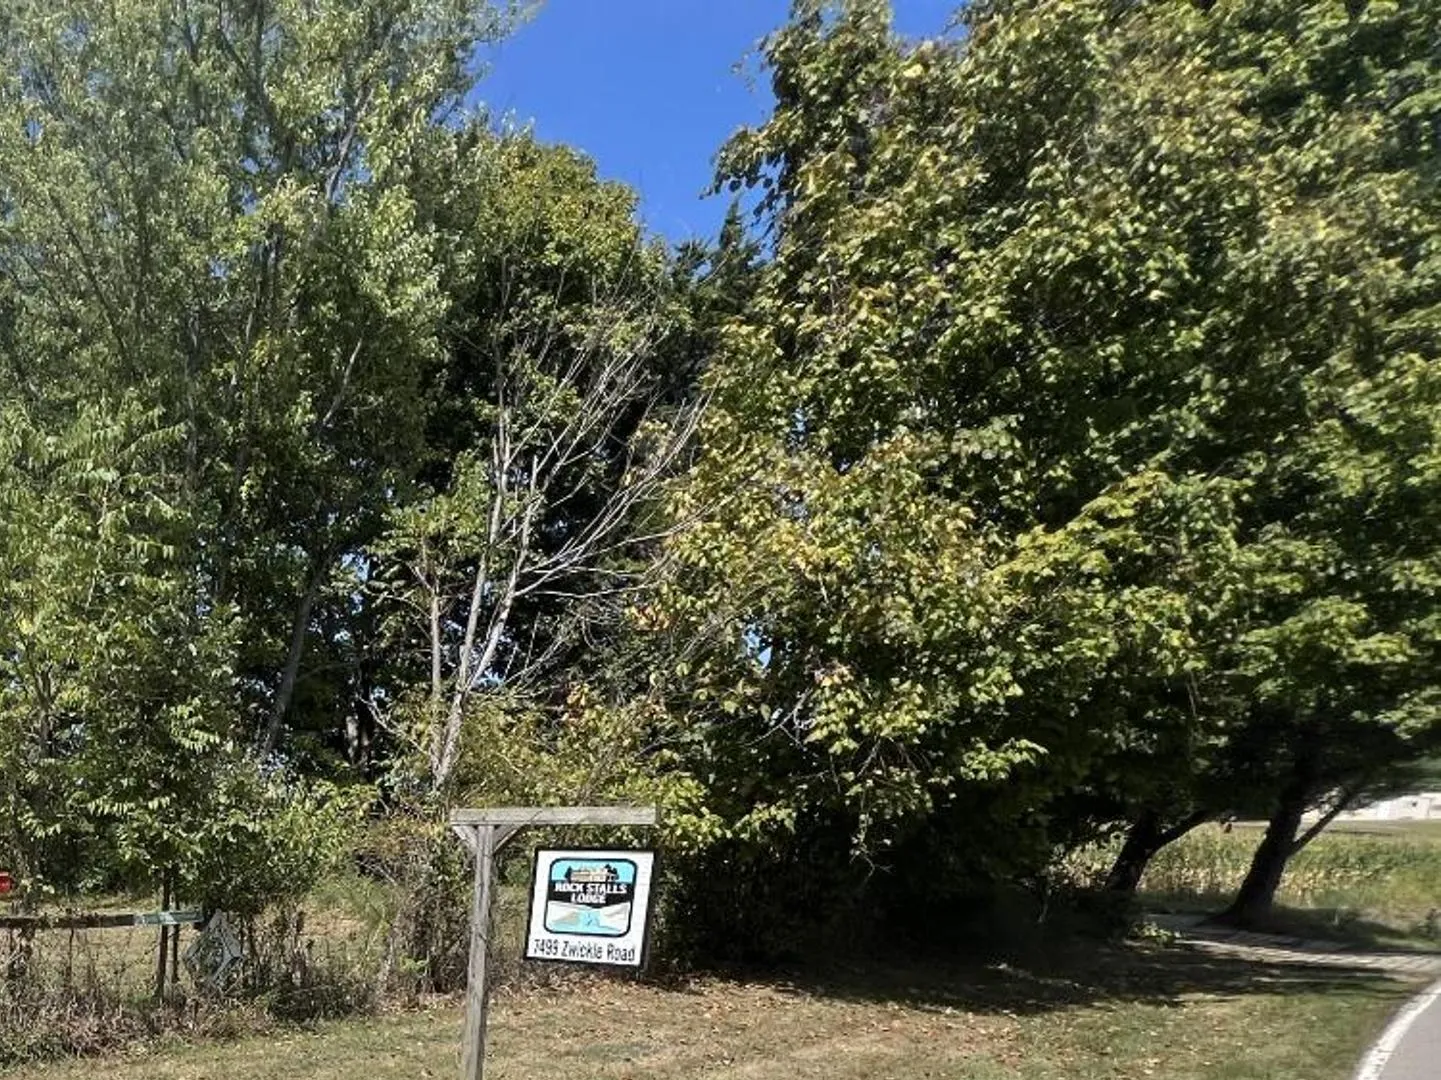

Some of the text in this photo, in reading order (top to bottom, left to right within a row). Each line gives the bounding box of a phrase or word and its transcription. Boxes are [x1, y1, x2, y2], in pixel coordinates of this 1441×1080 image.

[554, 882, 627, 894] ROCK STALLS
[571, 893, 606, 904] LODGE
[561, 940, 603, 959] Zwickle
[606, 943, 636, 962] Road
